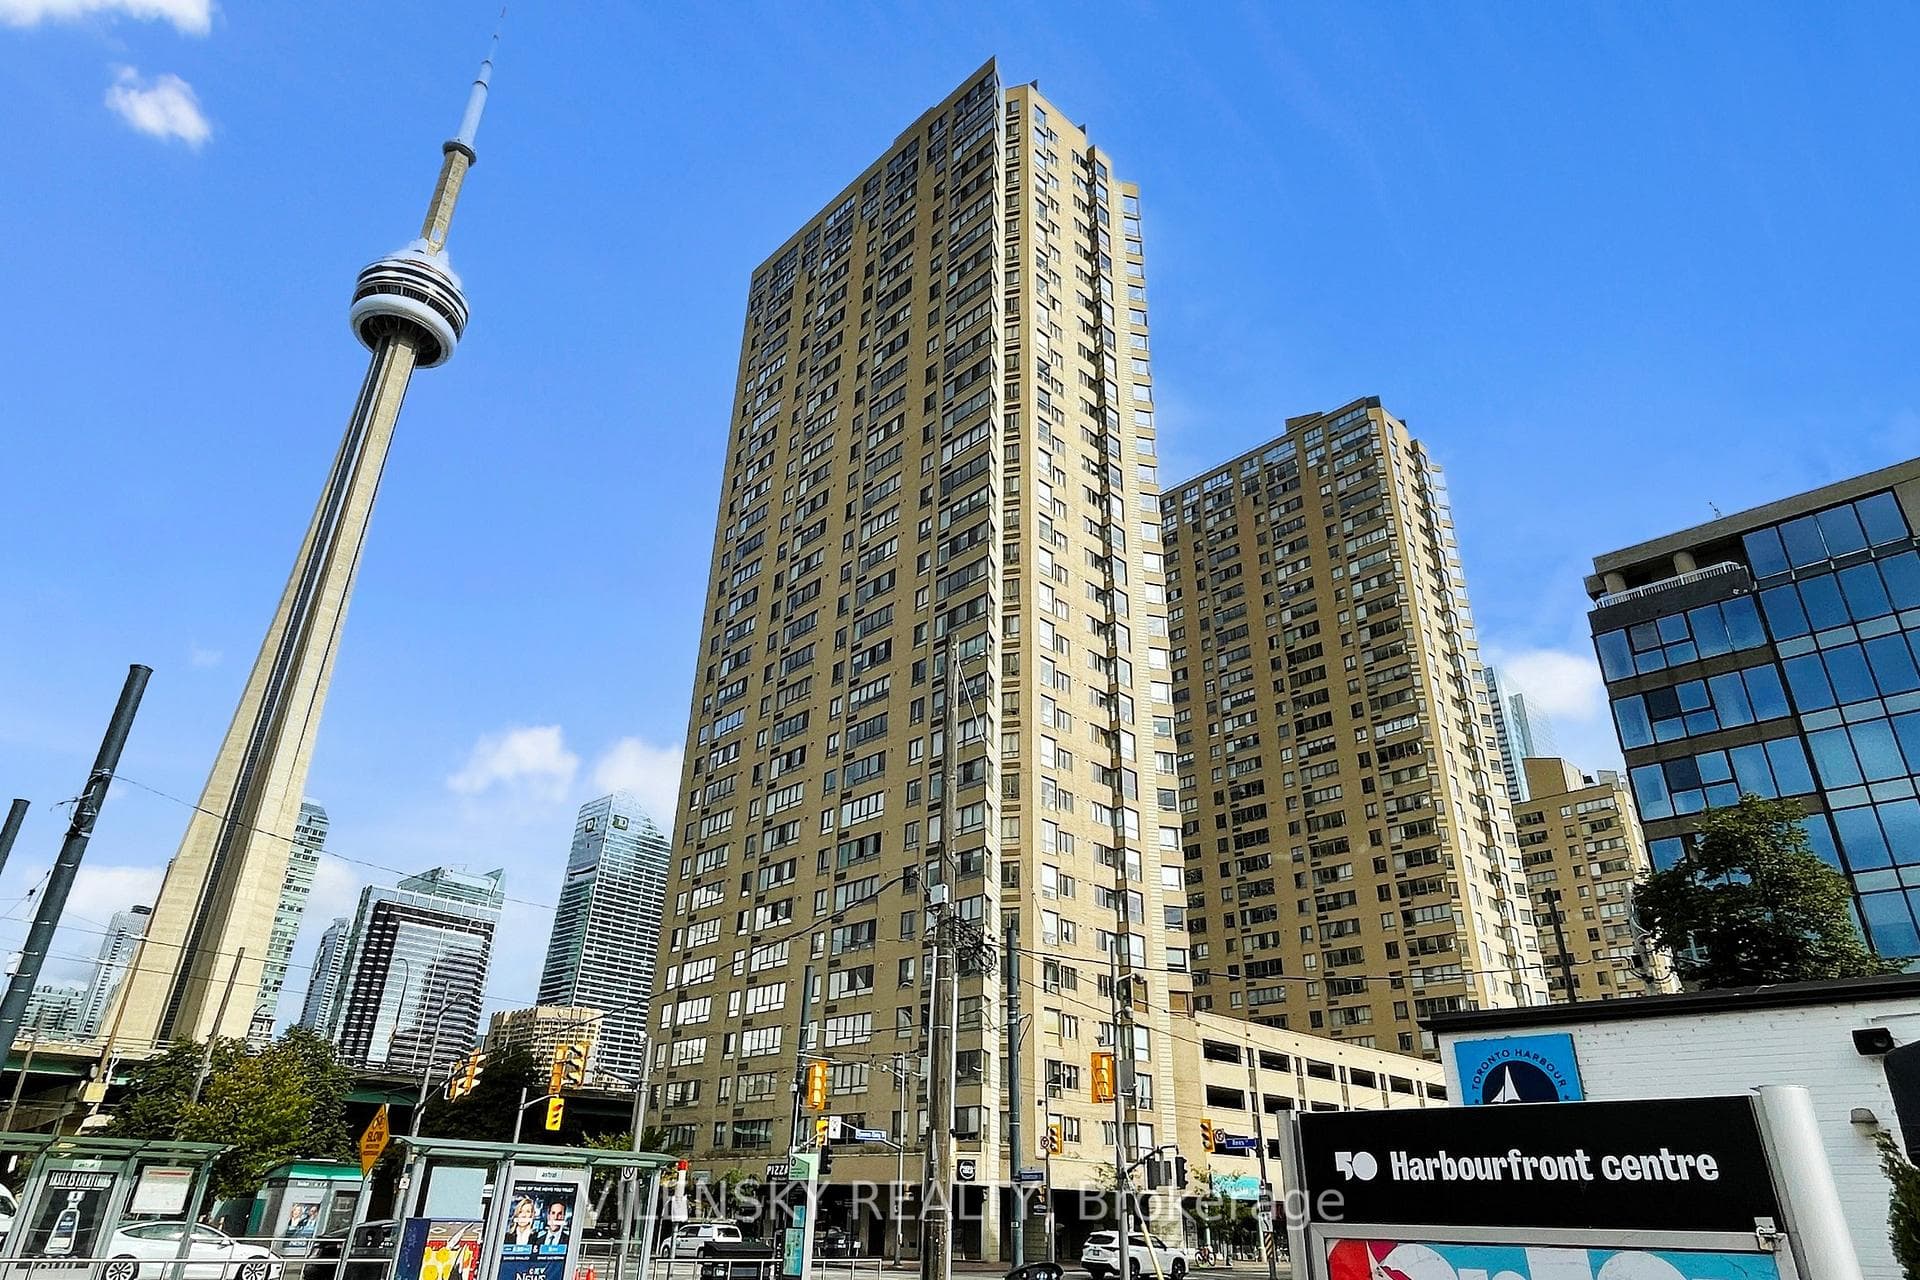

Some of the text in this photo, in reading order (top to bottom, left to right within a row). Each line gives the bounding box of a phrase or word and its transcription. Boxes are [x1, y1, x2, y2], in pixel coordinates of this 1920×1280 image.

[1472, 1048, 1567, 1090] TORONTO HARBOUR
[1389, 1149, 1594, 1181] Harbourfront
[1601, 1147, 1720, 1181] centre
